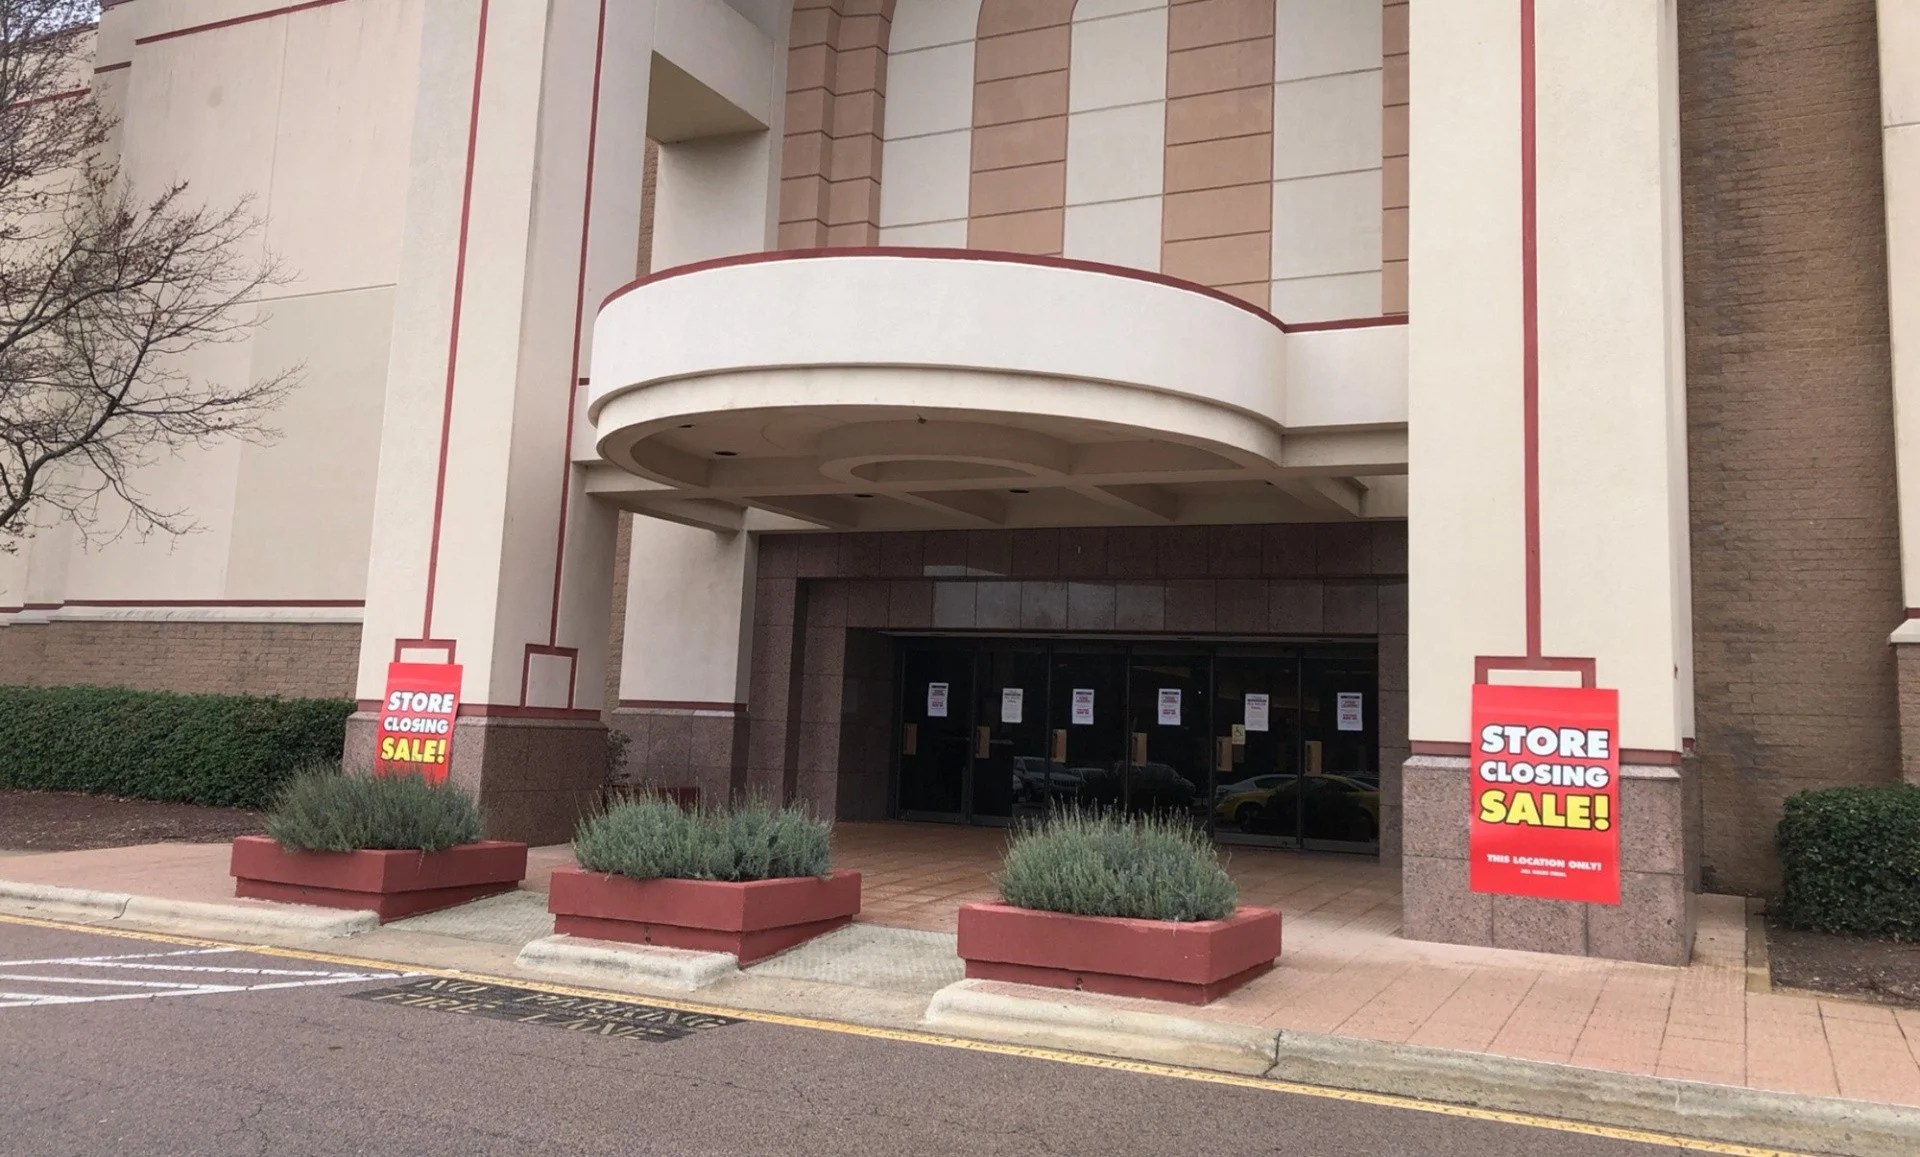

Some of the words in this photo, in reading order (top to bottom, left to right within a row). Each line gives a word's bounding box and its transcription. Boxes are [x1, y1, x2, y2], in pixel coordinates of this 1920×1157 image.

[387, 691, 455, 714] STORE
[383, 716, 449, 734] CLOSING
[380, 736, 447, 764] SALE!
[1480, 723, 1610, 759] STORE
[1479, 760, 1610, 789] CLOSING
[1479, 789, 1611, 832] SALE!
[1486, 853, 1511, 864] THIS
[1513, 855, 1566, 869] LOCATION
[1568, 860, 1602, 871] ONLY!
